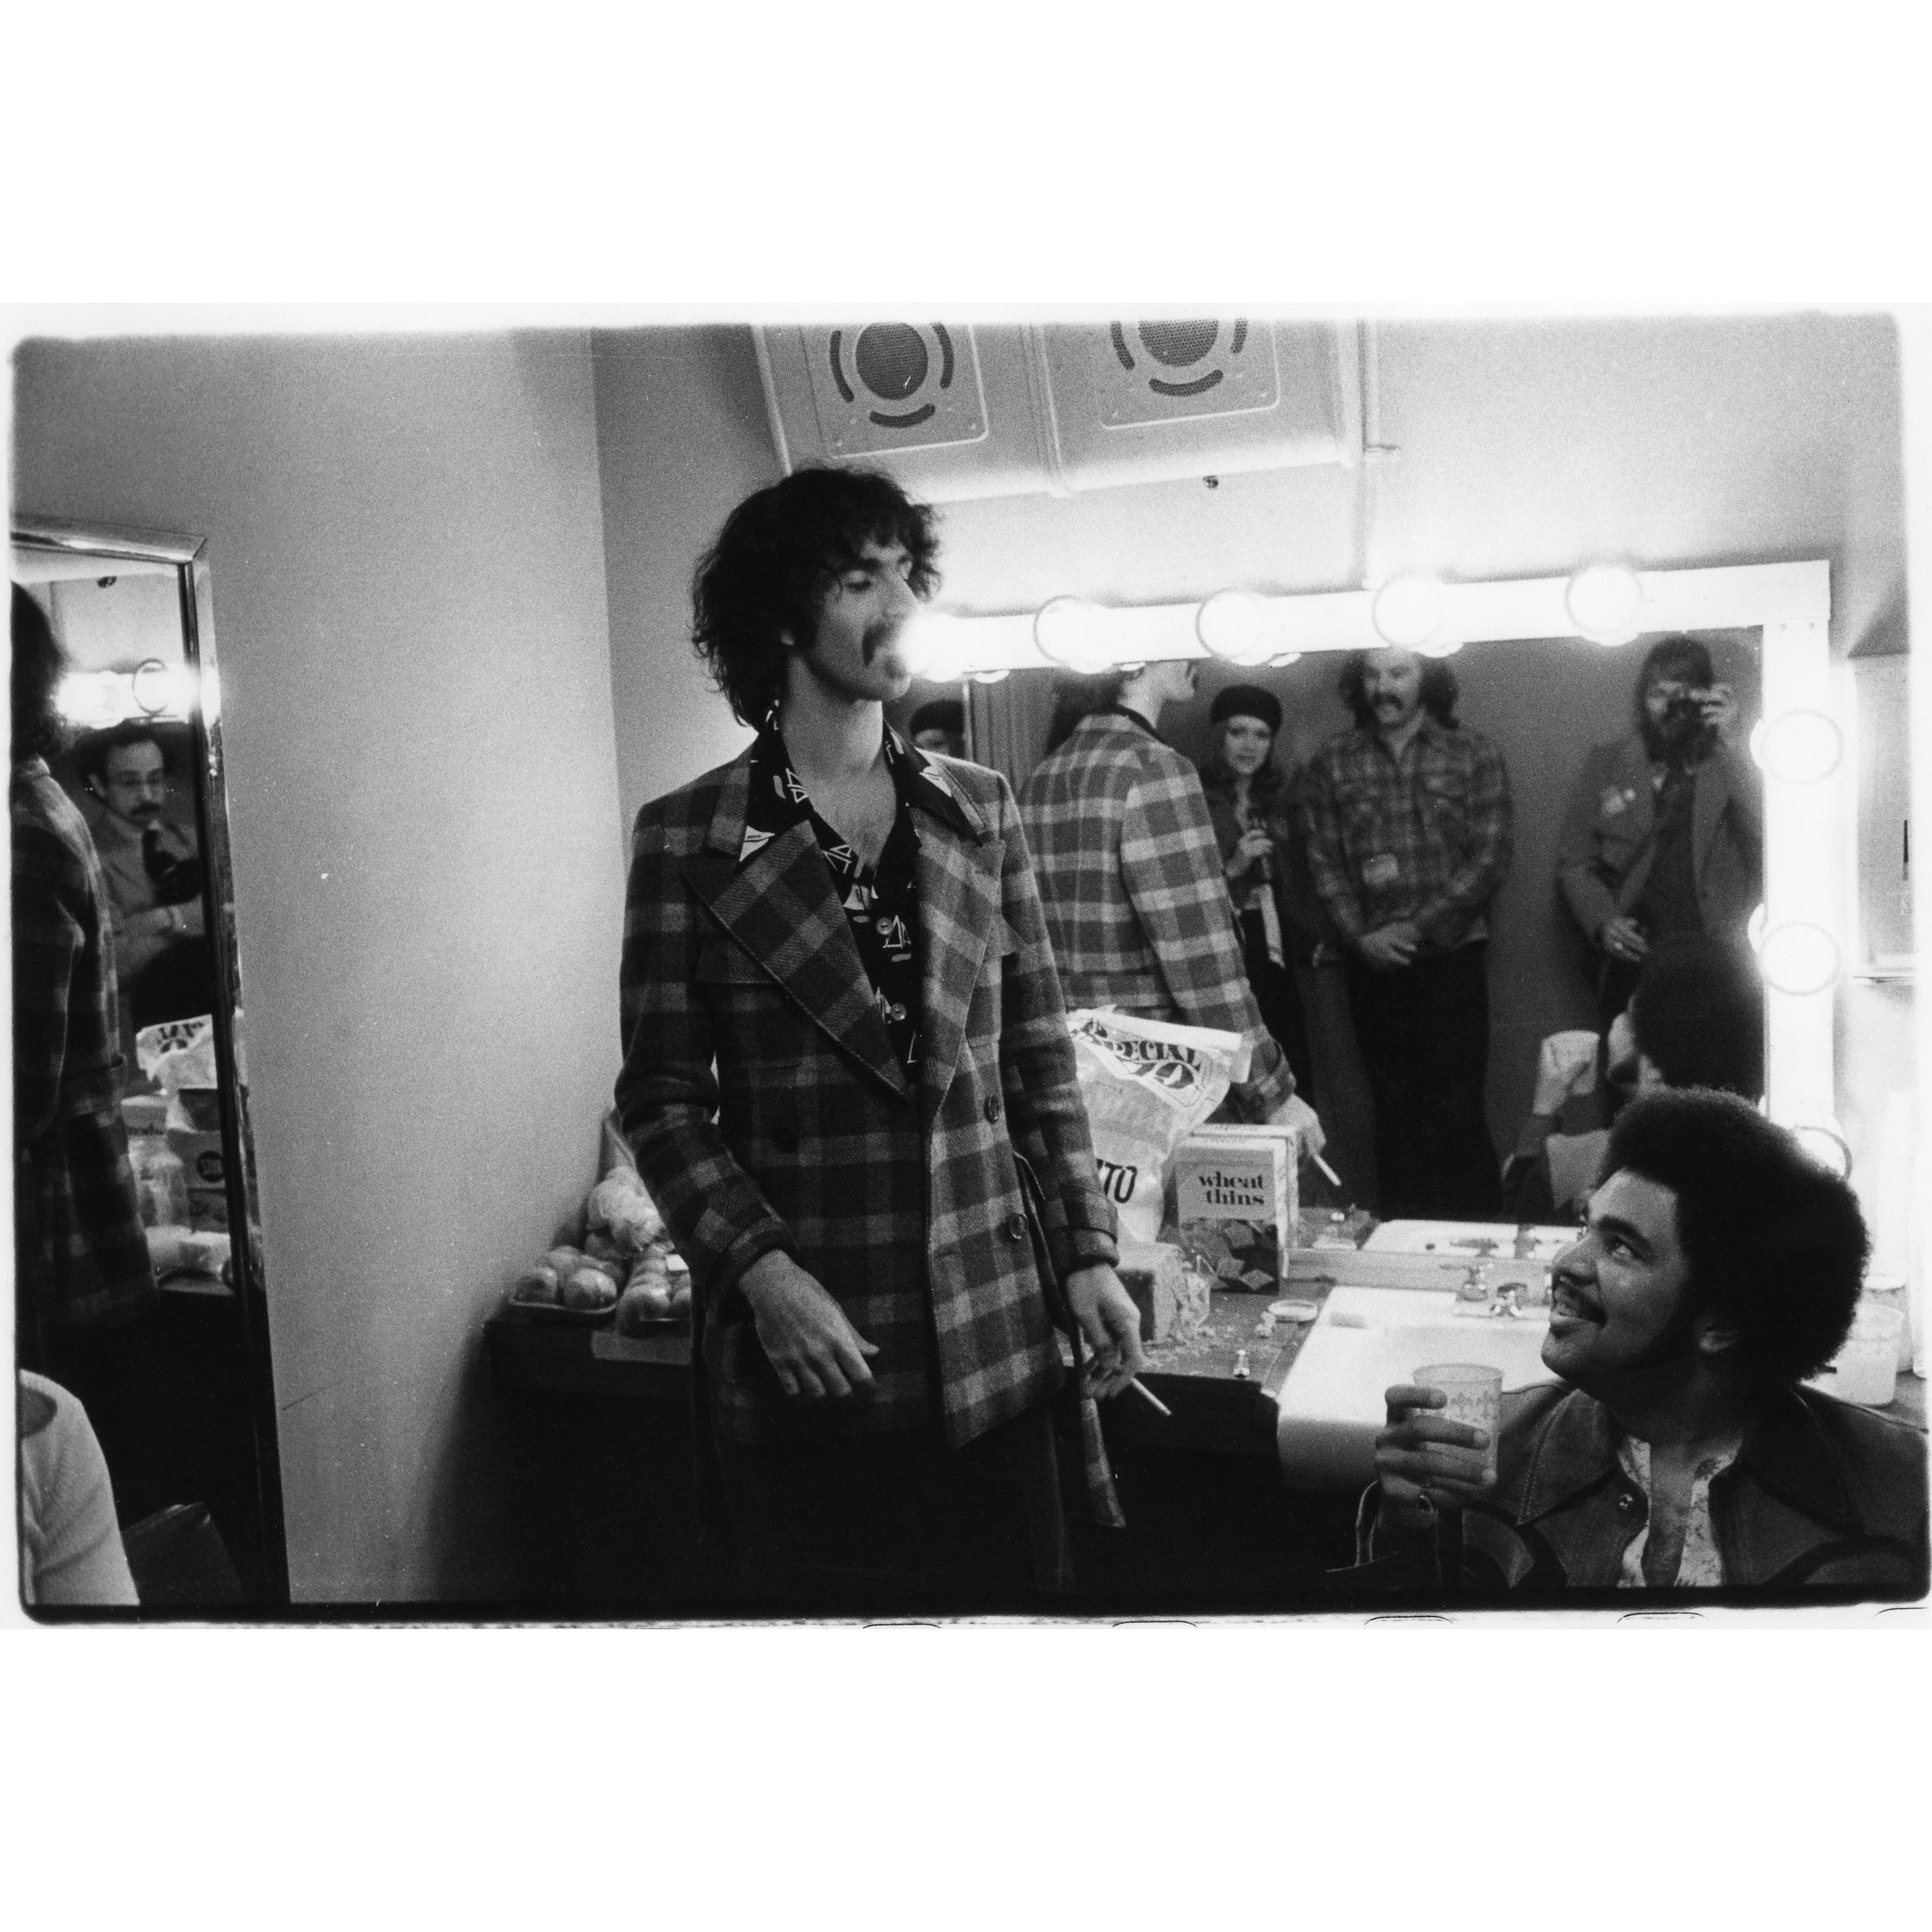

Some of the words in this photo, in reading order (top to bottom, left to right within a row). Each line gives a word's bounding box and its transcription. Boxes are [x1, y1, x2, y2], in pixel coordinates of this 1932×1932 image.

[1096, 1159, 1137, 1203] TO
[1199, 1171, 1263, 1189] wheat
[1206, 1189, 1264, 1206] thins
